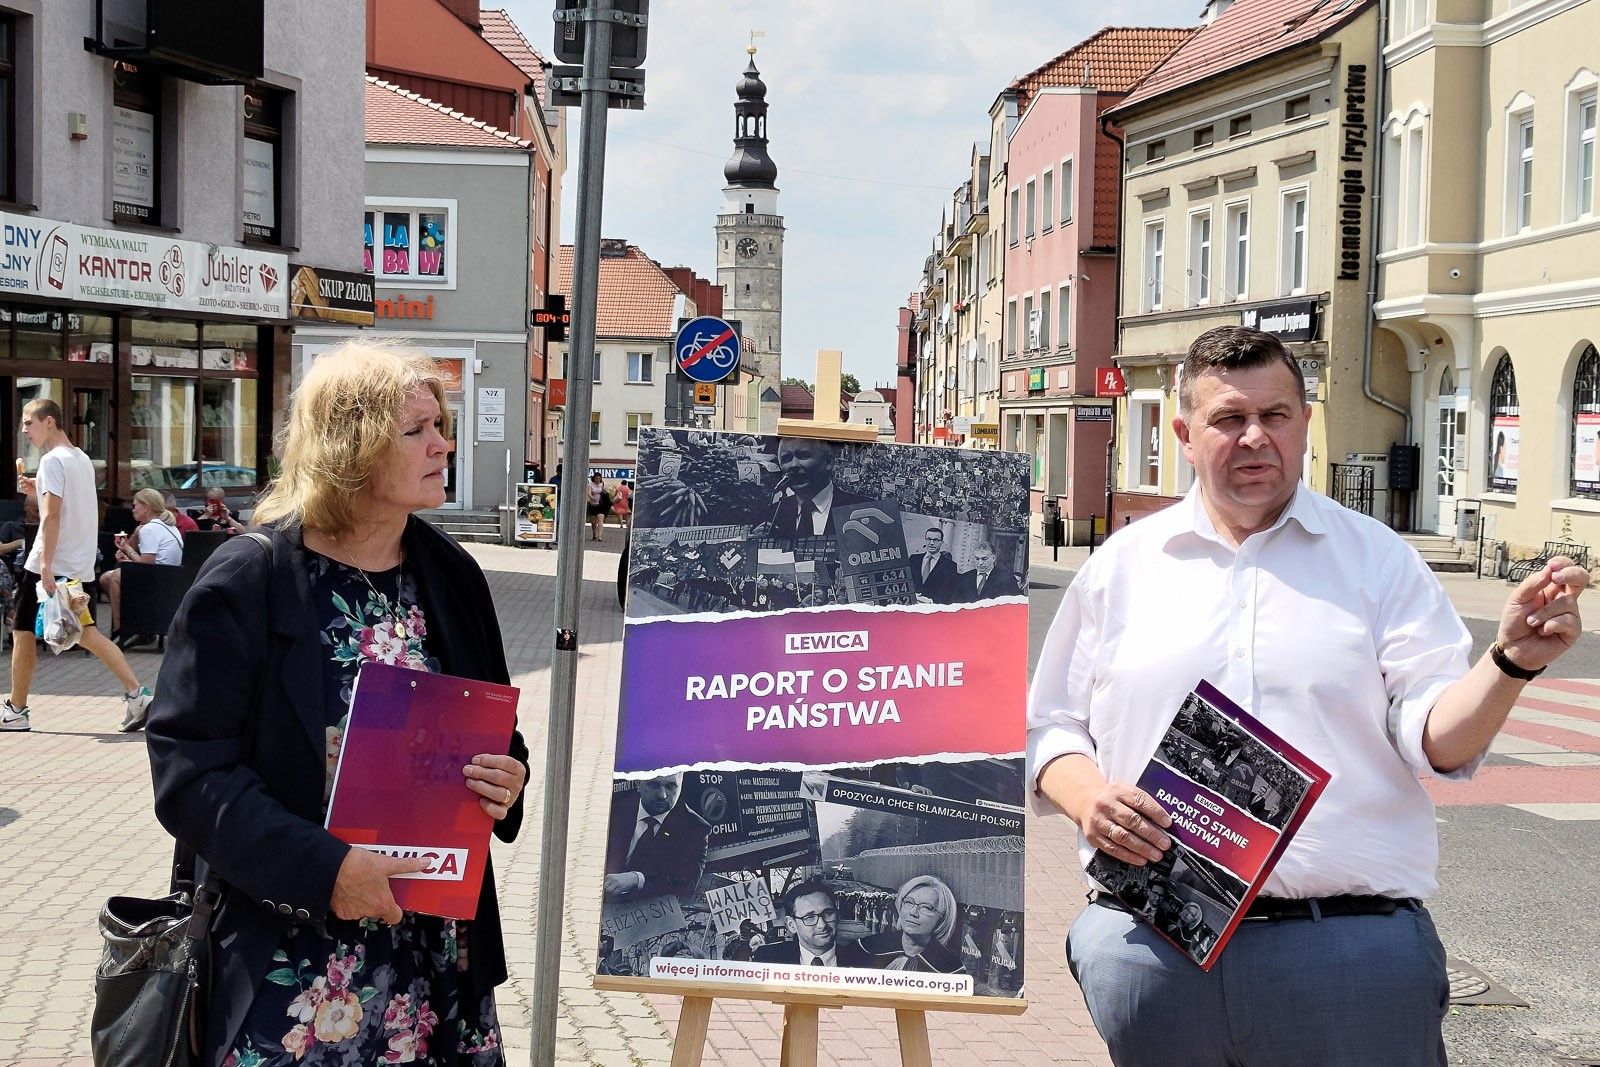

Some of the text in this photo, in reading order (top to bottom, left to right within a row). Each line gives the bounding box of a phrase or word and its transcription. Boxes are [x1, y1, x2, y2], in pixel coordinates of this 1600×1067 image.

[1341, 64, 1367, 162] fryzjerstwo
[1337, 170, 1365, 280] kosmetologia
[80, 233, 148, 253] WYMIANA WALUT
[79, 254, 152, 282] KANTOR
[202, 252, 254, 287] Jubiler
[319, 278, 373, 302] SKUP ZŁOTA
[974, 428, 998, 436] LOMBARD
[848, 547, 901, 566] ORLEN
[790, 634, 864, 651] LEWICA
[686, 661, 964, 700] RAPORT O STANIE
[747, 697, 901, 731] PAŃSTWA
[700, 774, 723, 785] STOP
[832, 788, 885, 806] OPOZYCJA
[887, 798, 914, 810] CHCE
[916, 803, 978, 822] ISLAMIZACJI
[980, 814, 1020, 829] POLSKI?
[1156, 788, 1249, 849] RAPORT O STANIE
[1196, 795, 1222, 814] LEWICA
[1170, 811, 1221, 848] PAŃSTWA
[706, 881, 768, 909] WALKA
[714, 903, 760, 928] TRWA
[961, 946, 981, 958] POLICJA
[991, 955, 1016, 970] POLICJA
[656, 962, 968, 993] więcej informacji na stronie www.lewica.org.pl
